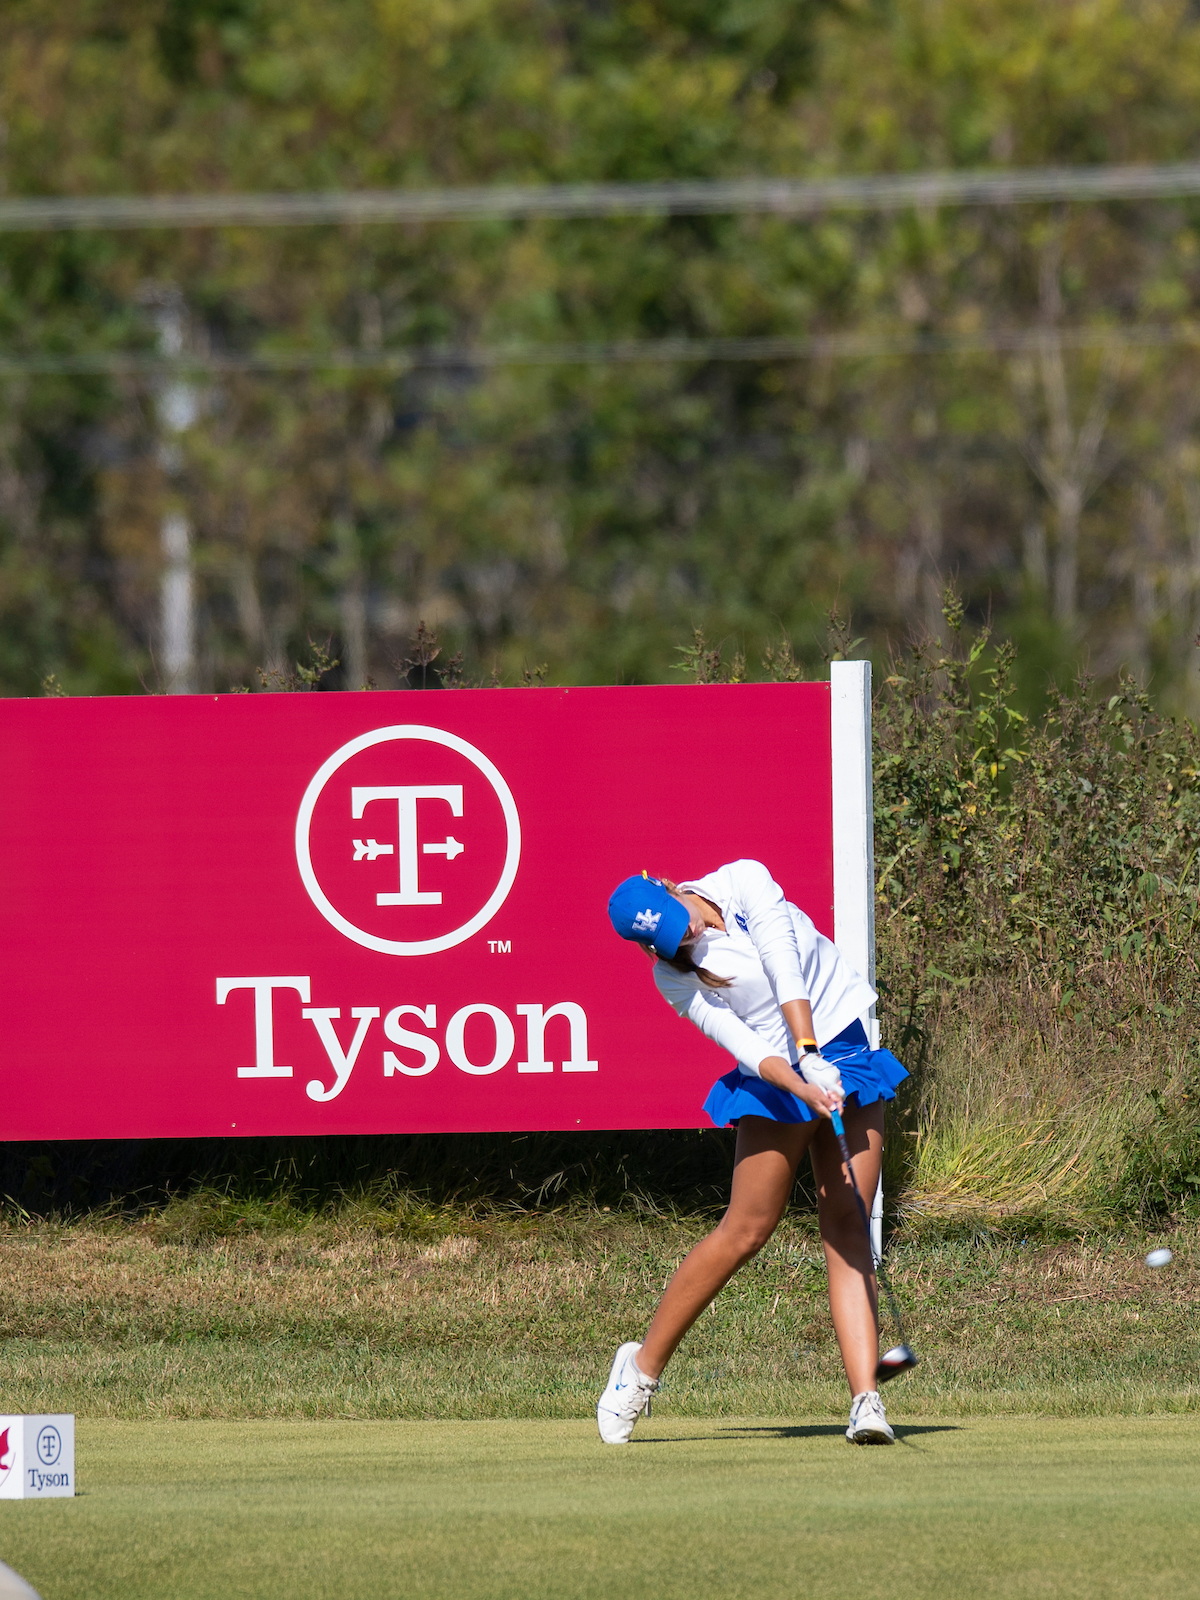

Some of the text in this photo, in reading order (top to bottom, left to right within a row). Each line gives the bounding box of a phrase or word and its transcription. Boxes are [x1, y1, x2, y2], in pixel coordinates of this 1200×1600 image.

[487, 940, 512, 954] TM
[215, 975, 599, 1103] Tyson
[28, 1468, 69, 1491] Tyson
